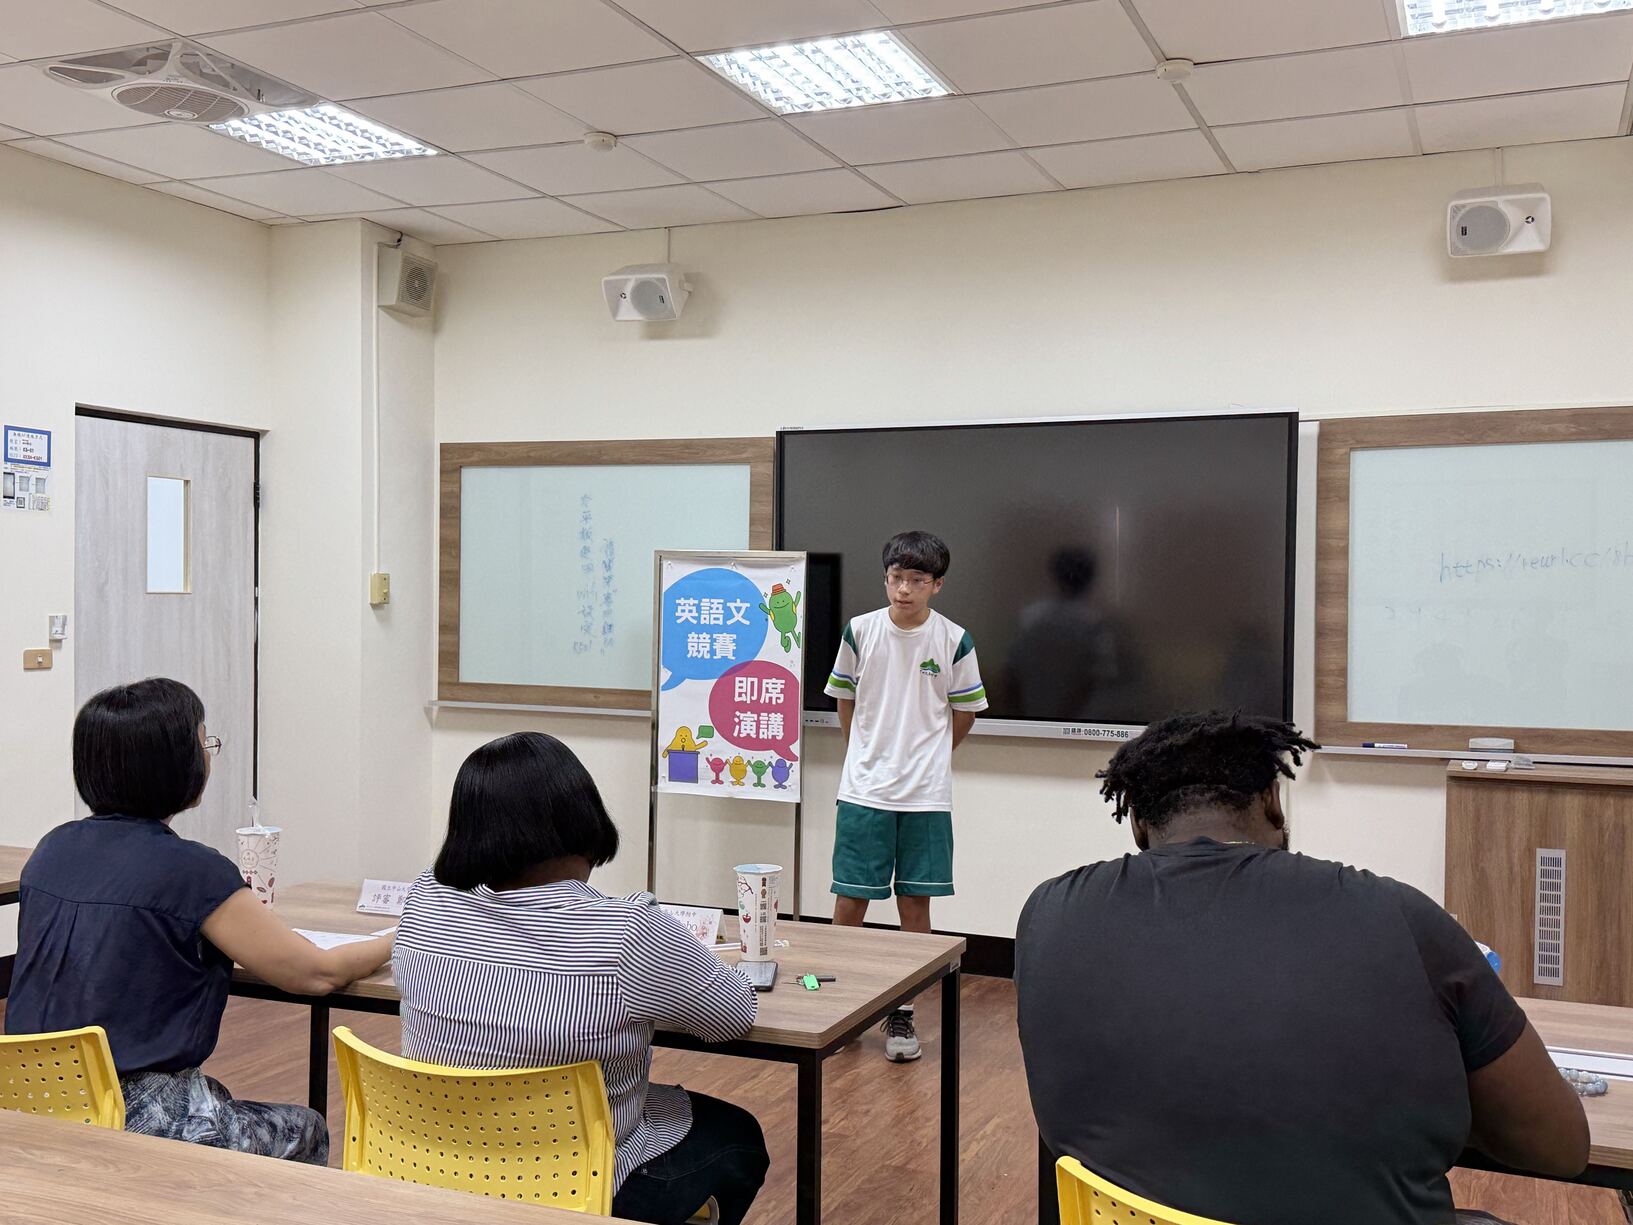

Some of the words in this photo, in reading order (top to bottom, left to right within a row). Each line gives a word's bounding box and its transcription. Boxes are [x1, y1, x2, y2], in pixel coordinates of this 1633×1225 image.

[675, 597, 750, 625] 英語文
[687, 631, 737, 660] 競賽
[733, 676, 786, 705] 即席
[732, 710, 785, 740] 演講
[1083, 728, 1129, 739] 0800-775-886
